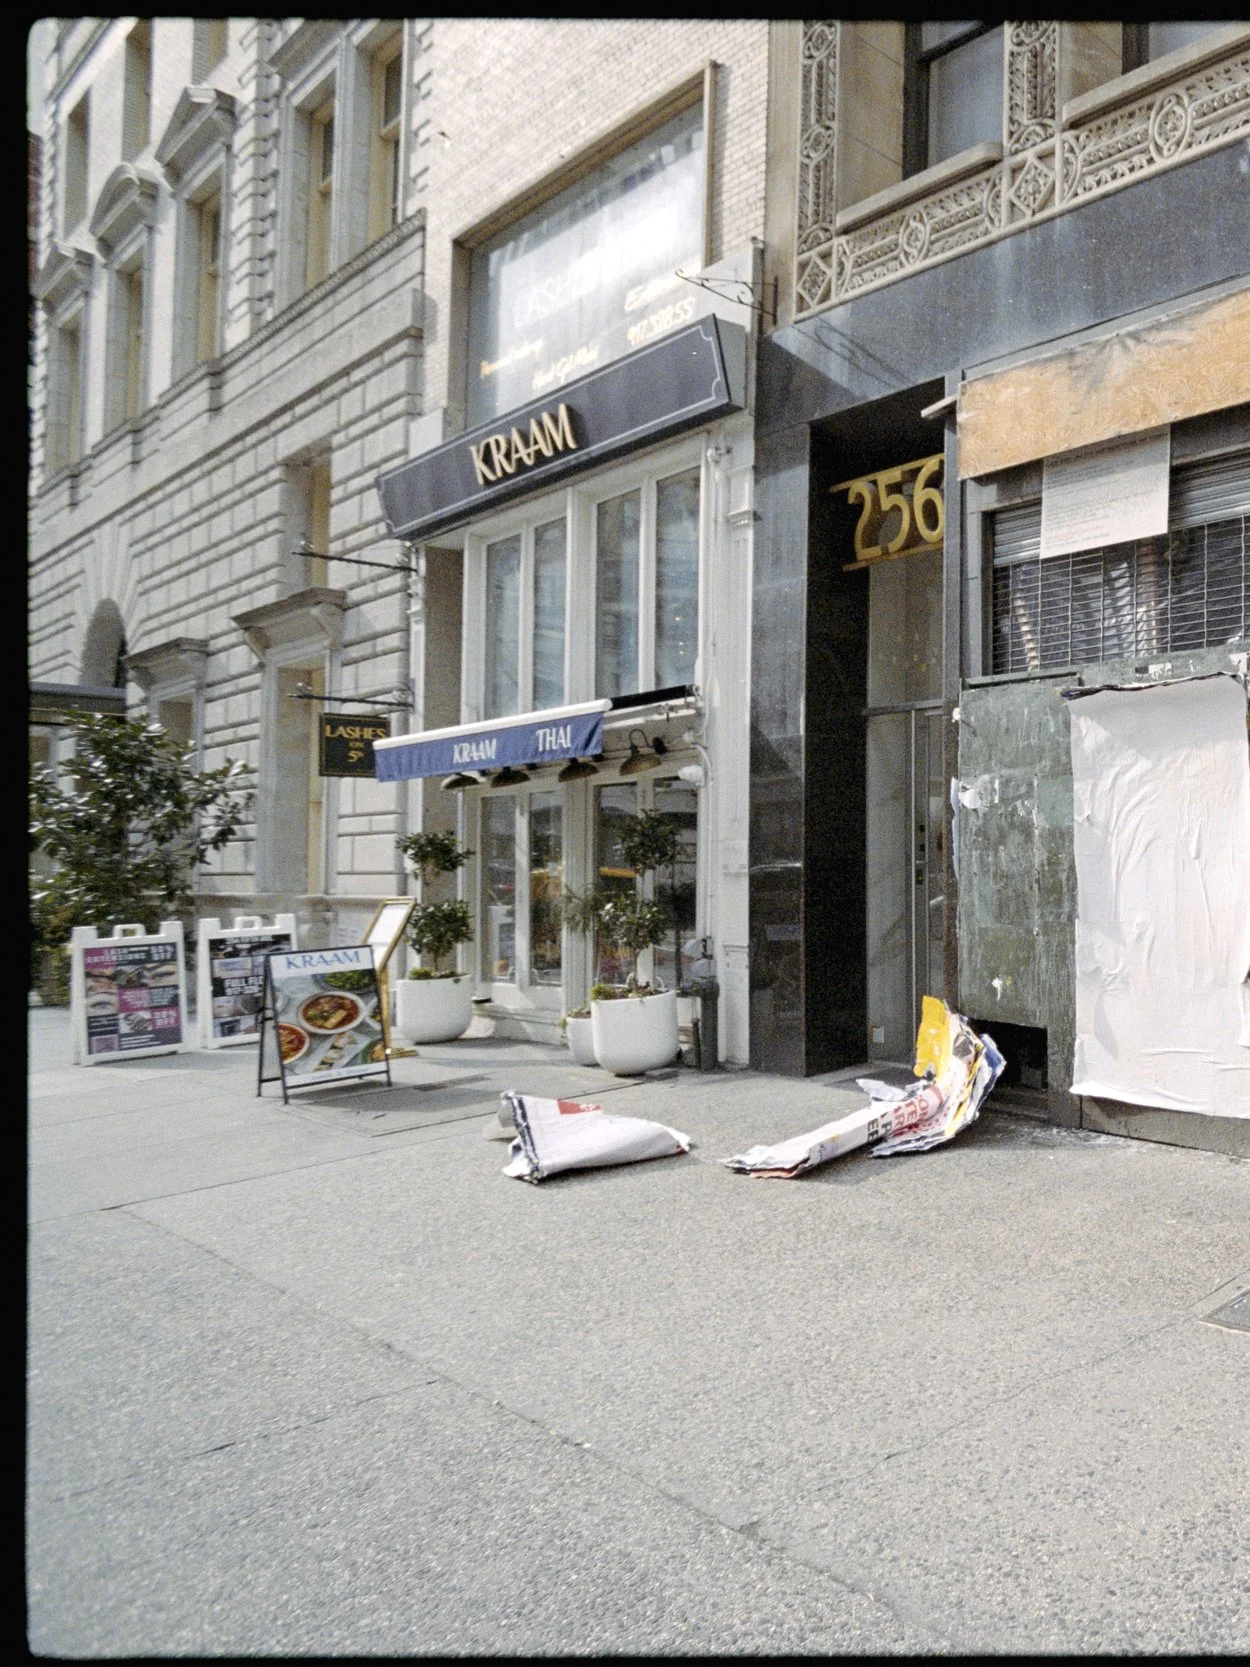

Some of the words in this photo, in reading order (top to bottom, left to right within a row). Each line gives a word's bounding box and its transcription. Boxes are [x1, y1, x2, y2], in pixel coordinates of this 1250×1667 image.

[470, 403, 577, 485] KRAAM
[848, 457, 944, 560] 256
[323, 725, 386, 739] LASHES
[453, 739, 497, 764] KRAAM
[535, 725, 571, 752] THAI
[285, 950, 361, 969] KRAAM
